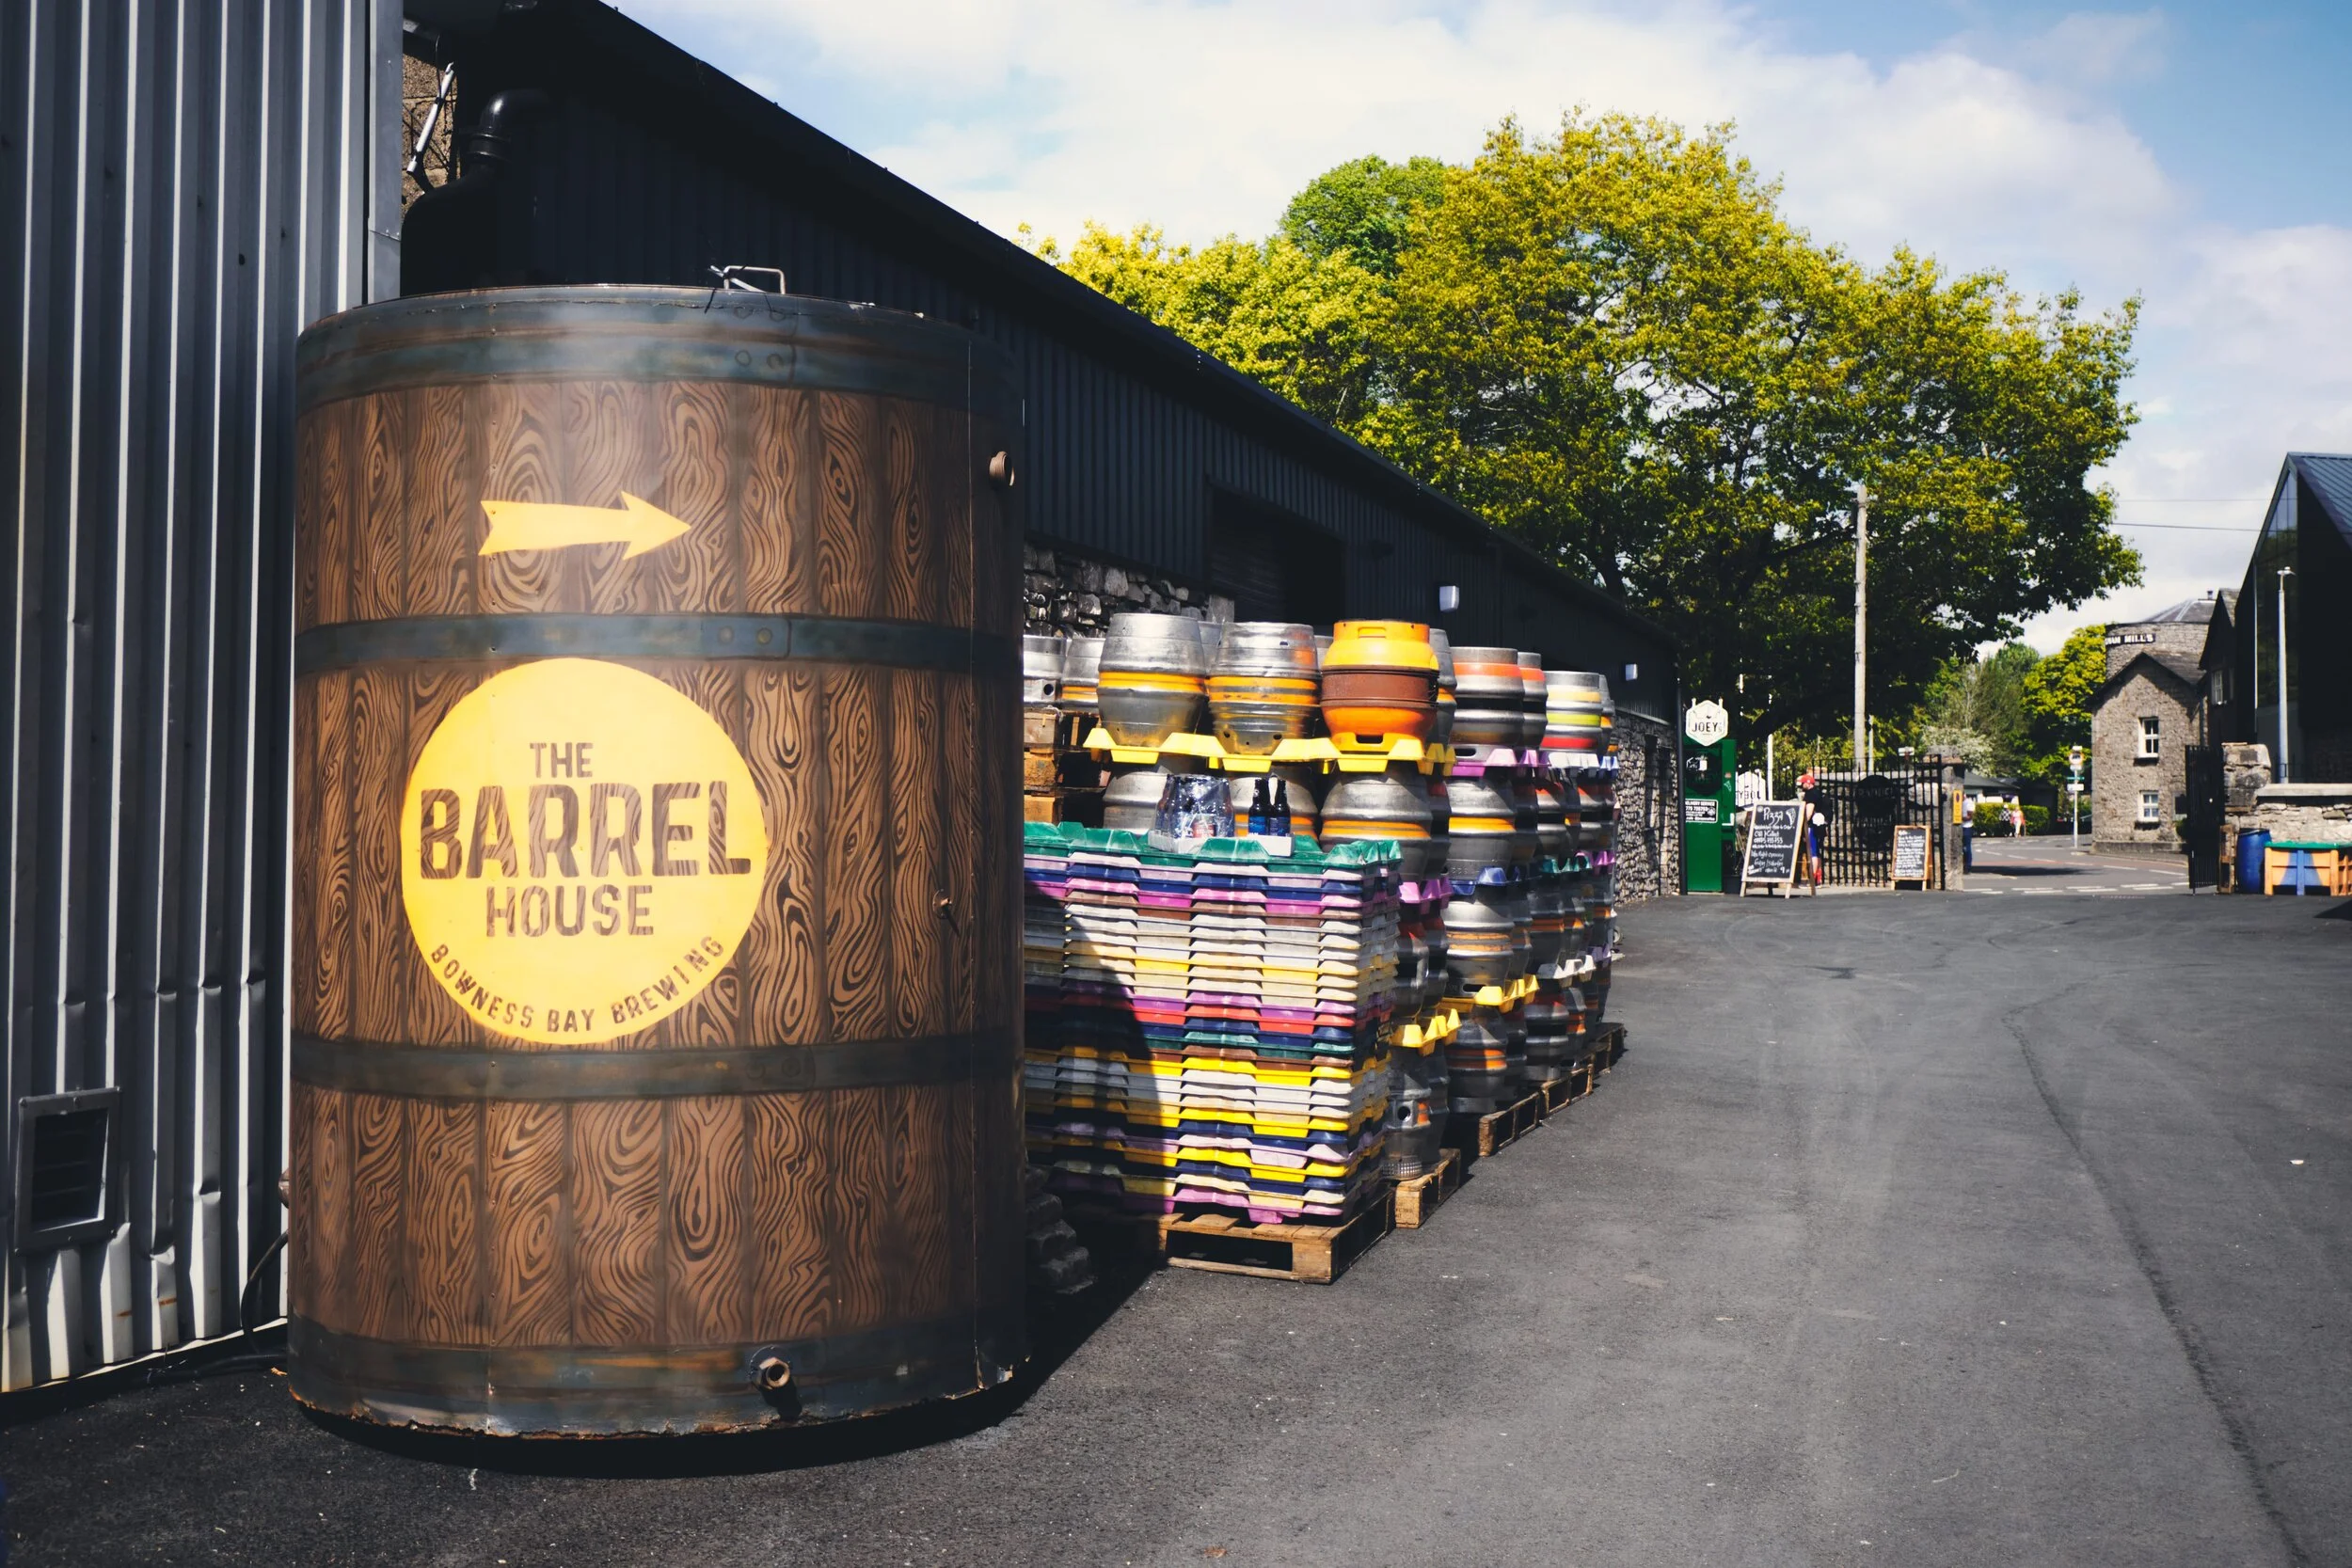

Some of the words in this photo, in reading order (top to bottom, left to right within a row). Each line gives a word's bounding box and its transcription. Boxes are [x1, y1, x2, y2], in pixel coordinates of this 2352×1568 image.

[2123, 634, 2153, 643] MILLS
[529, 742, 594, 779] THE
[420, 780, 752, 879] BARREL
[1763, 806, 1784, 828] Pizza
[485, 884, 654, 938] HOUSE
[430, 943, 533, 1029] BOWNESS
[547, 1008, 595, 1033] BAY
[611, 935, 724, 1025] BREWING
